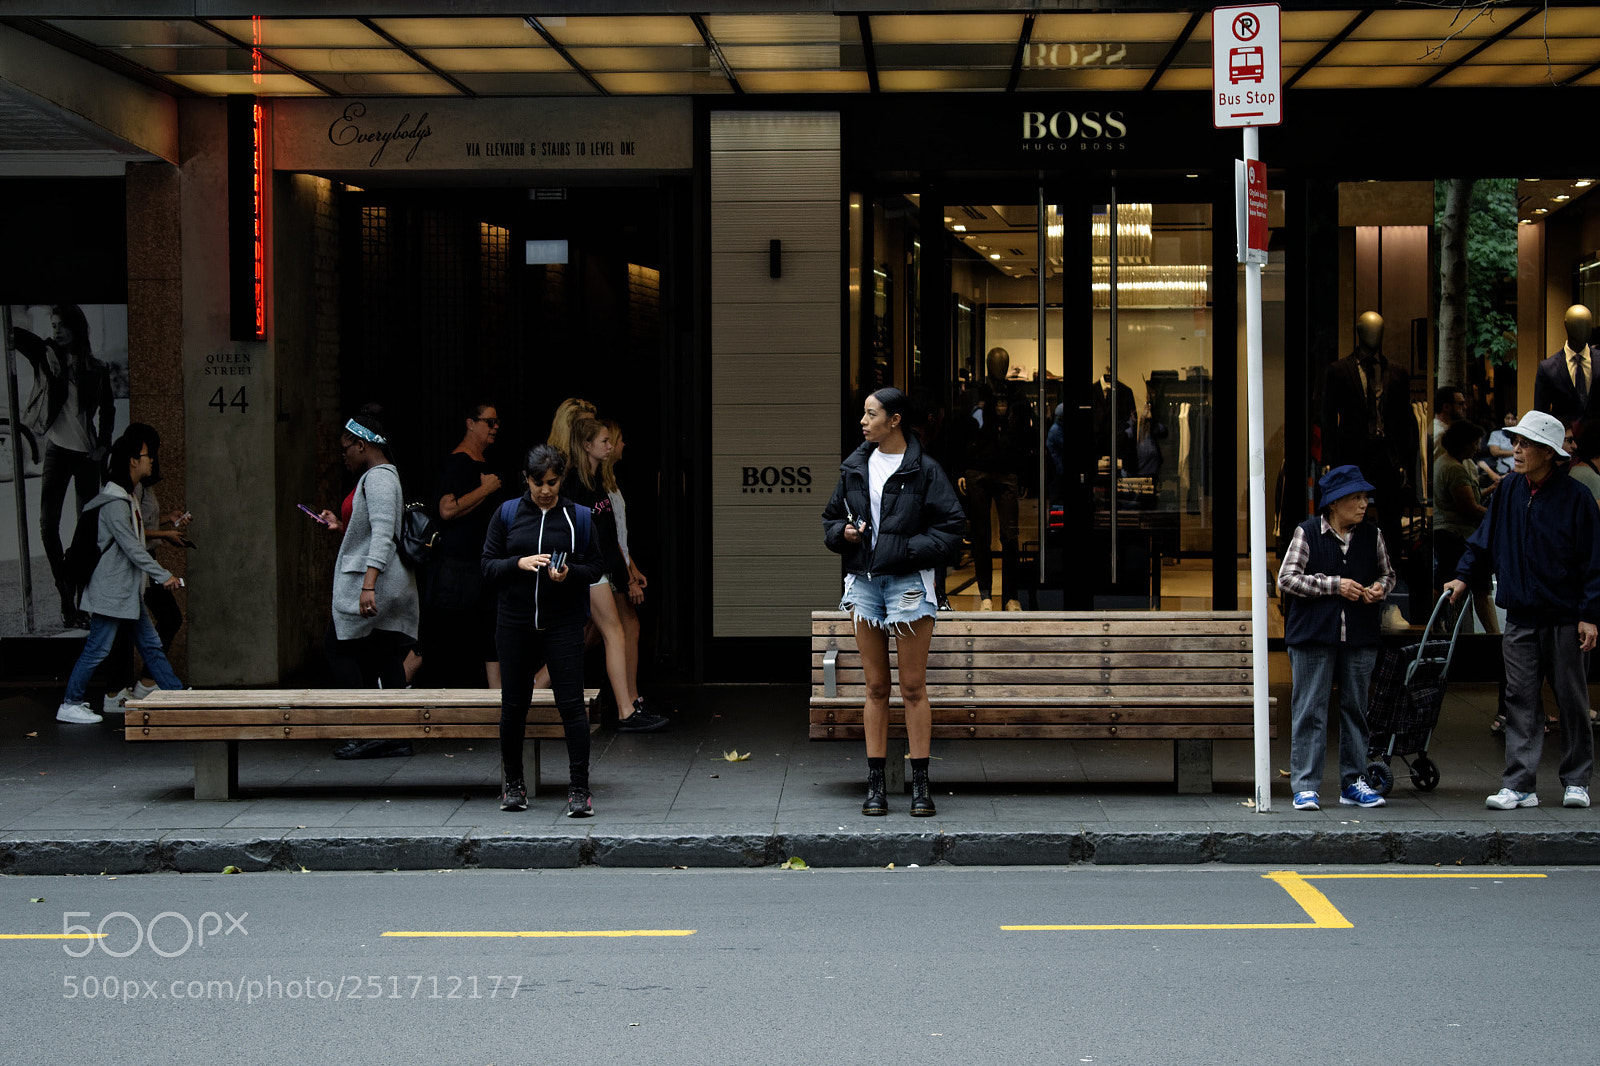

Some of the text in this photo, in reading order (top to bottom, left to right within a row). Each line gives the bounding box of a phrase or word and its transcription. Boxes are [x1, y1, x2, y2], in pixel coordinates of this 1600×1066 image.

[1219, 91, 1275, 106] Bus Stop
[1022, 111, 1127, 139] BOSS
[466, 143, 480, 157] VIA
[486, 143, 525, 157] ELEVATOR
[542, 143, 571, 156] STAIRS
[576, 142, 586, 156] TO
[591, 142, 615, 156] LEVEL
[620, 142, 636, 156] ONE
[1022, 143, 1125, 151] HUGO BOSS
[206, 353, 251, 364] QUEEN
[204, 366, 253, 376] STREET
[208, 386, 250, 414] 44
[742, 466, 812, 486] BOSS
